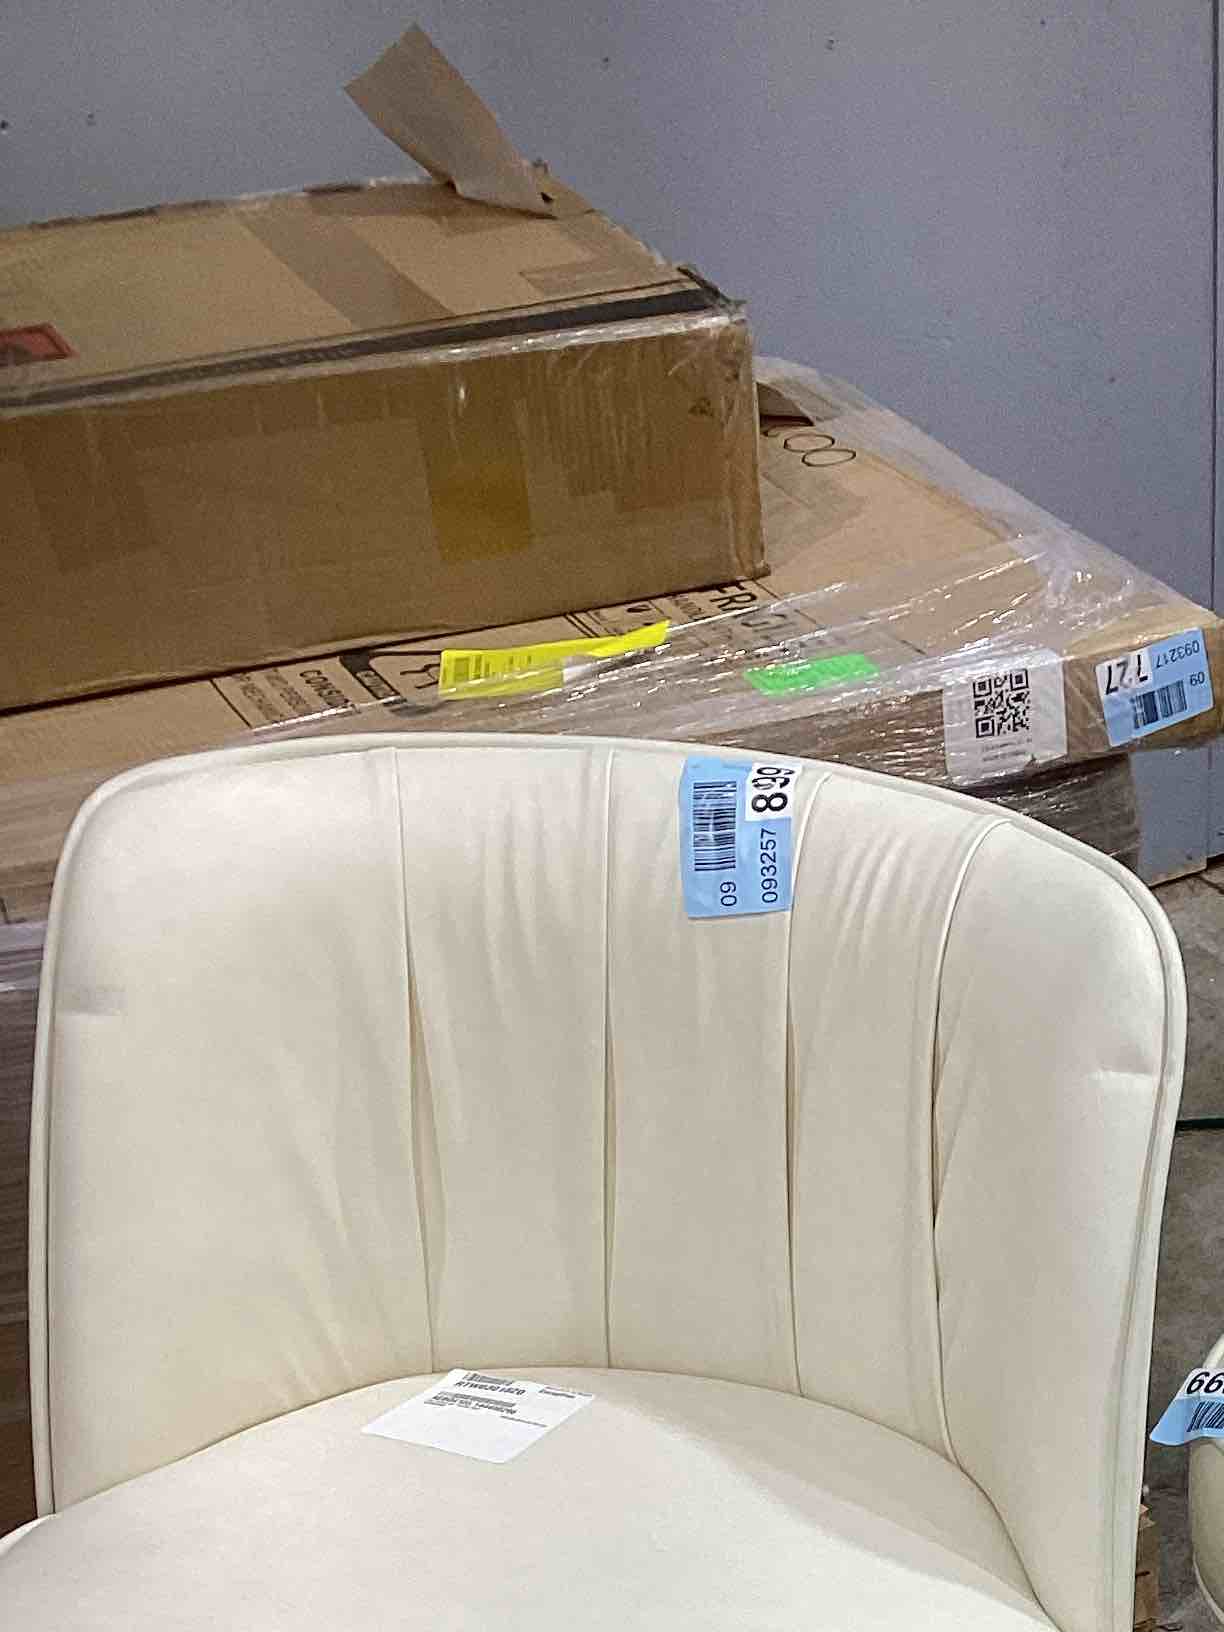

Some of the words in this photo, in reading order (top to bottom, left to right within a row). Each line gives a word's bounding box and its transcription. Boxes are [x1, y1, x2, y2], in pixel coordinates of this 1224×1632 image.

[1106, 654, 1149, 695] 727
[1190, 672, 1205, 686] 09
[751, 767, 795, 813] 899
[760, 828, 778, 903] 093257
[720, 881, 738, 907] 09
